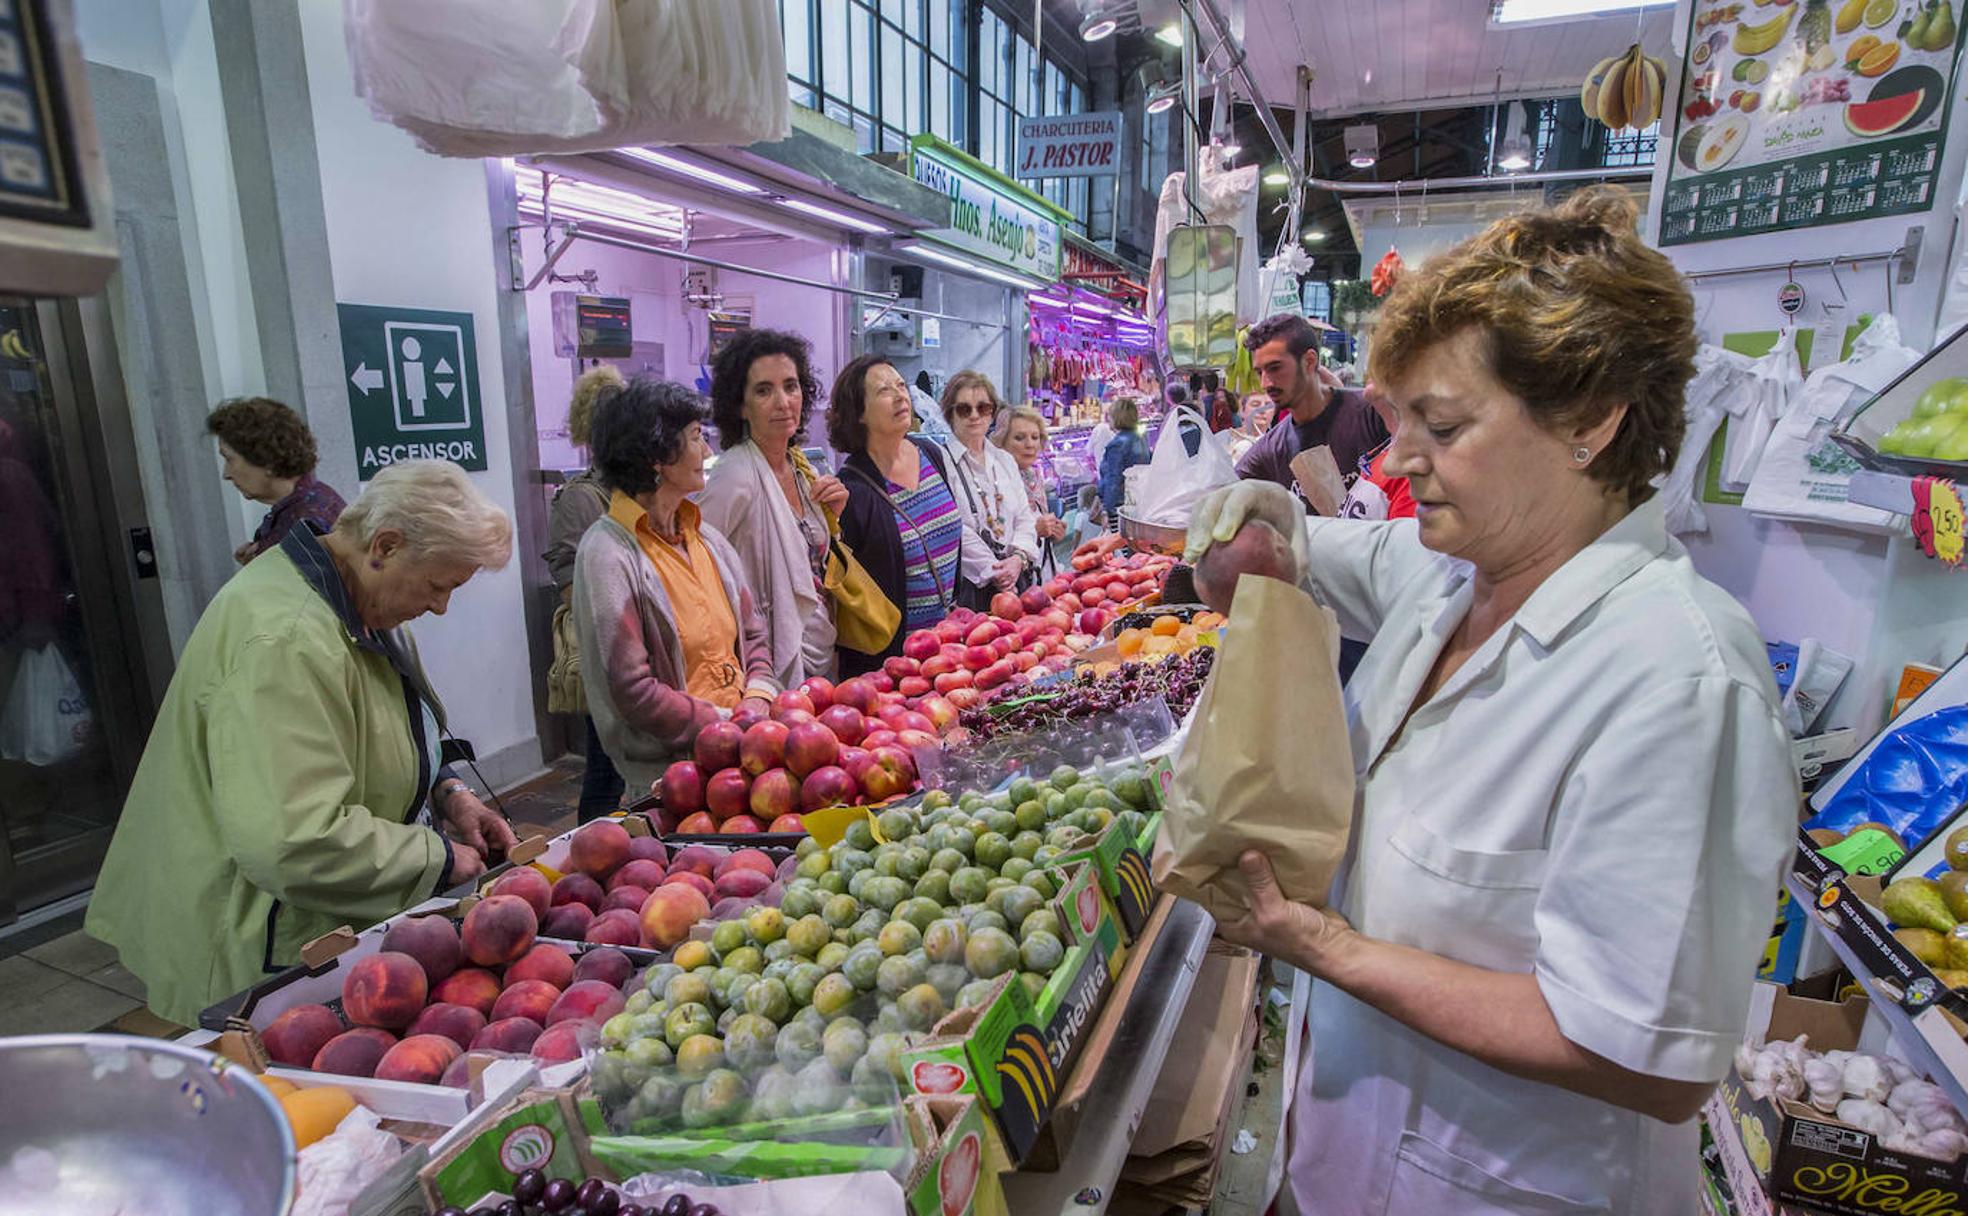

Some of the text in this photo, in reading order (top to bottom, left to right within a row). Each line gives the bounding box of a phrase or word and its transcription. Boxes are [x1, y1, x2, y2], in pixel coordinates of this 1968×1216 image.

[1021, 140, 1114, 171] J. PASTOR
[987, 196, 1025, 262] Asenjo
[362, 440, 477, 468] ASCENSOR
